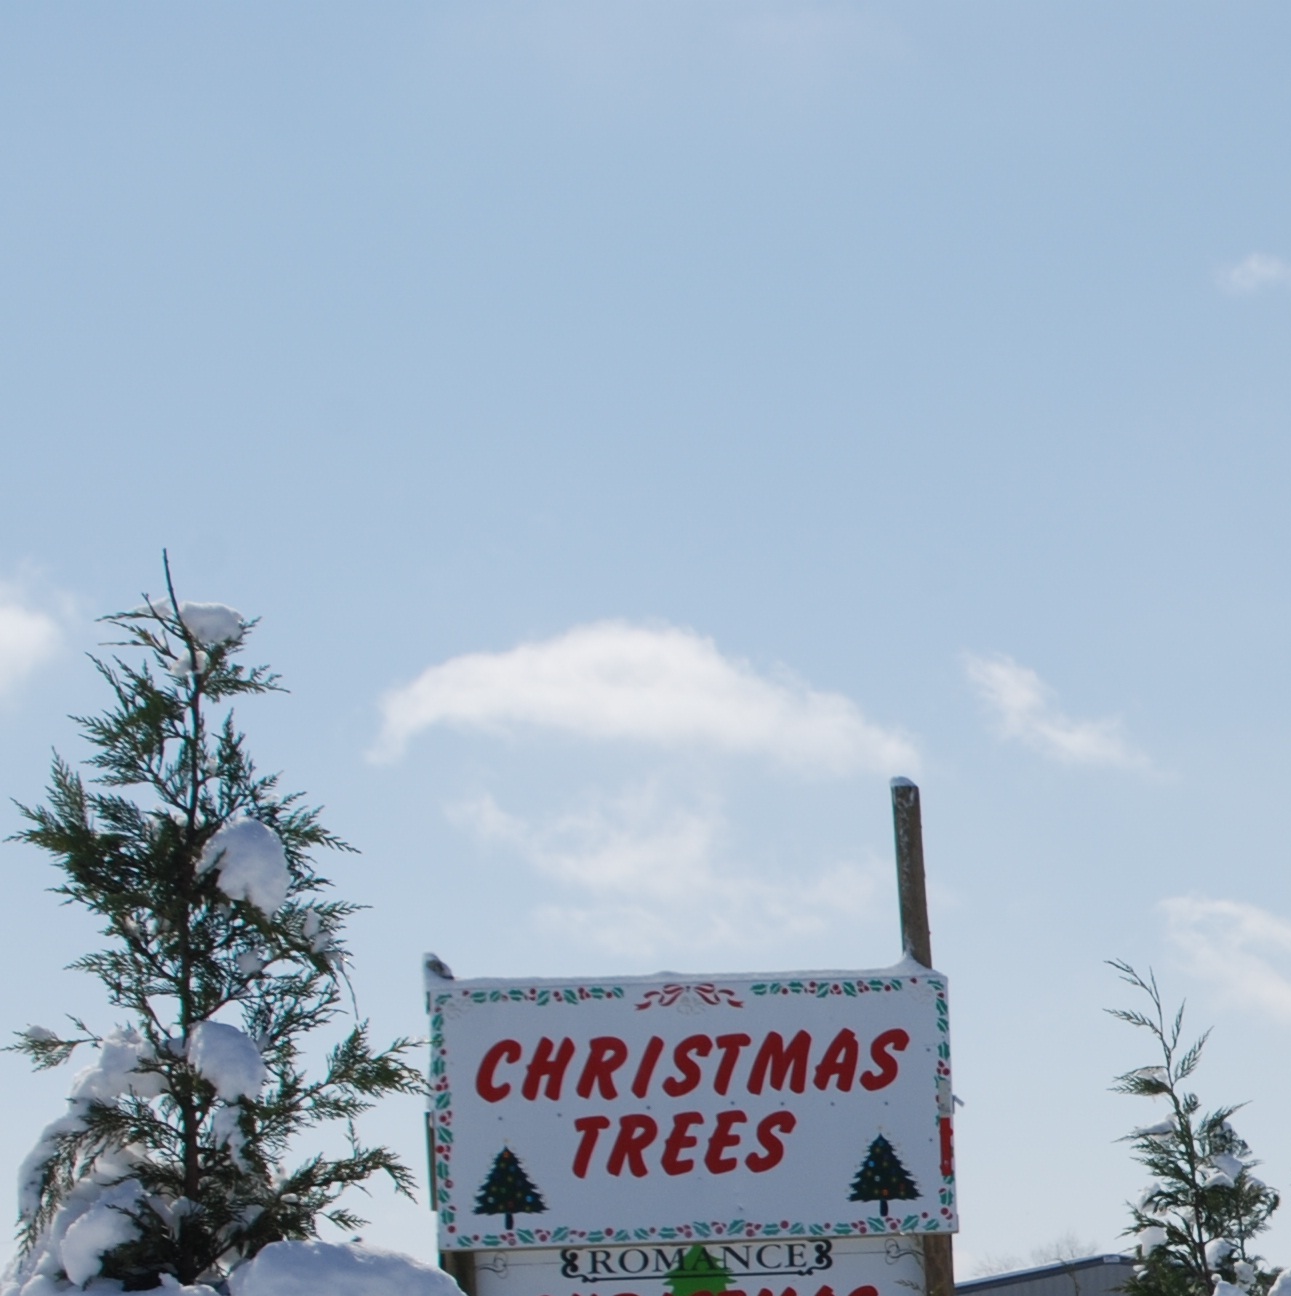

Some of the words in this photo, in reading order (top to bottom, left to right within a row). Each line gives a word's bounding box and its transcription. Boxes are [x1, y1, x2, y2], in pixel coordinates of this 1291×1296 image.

[475, 1027, 910, 1103] CHRISTMAS
[572, 1110, 797, 1179] TREES
[589, 1242, 808, 1274] ROMANCE
